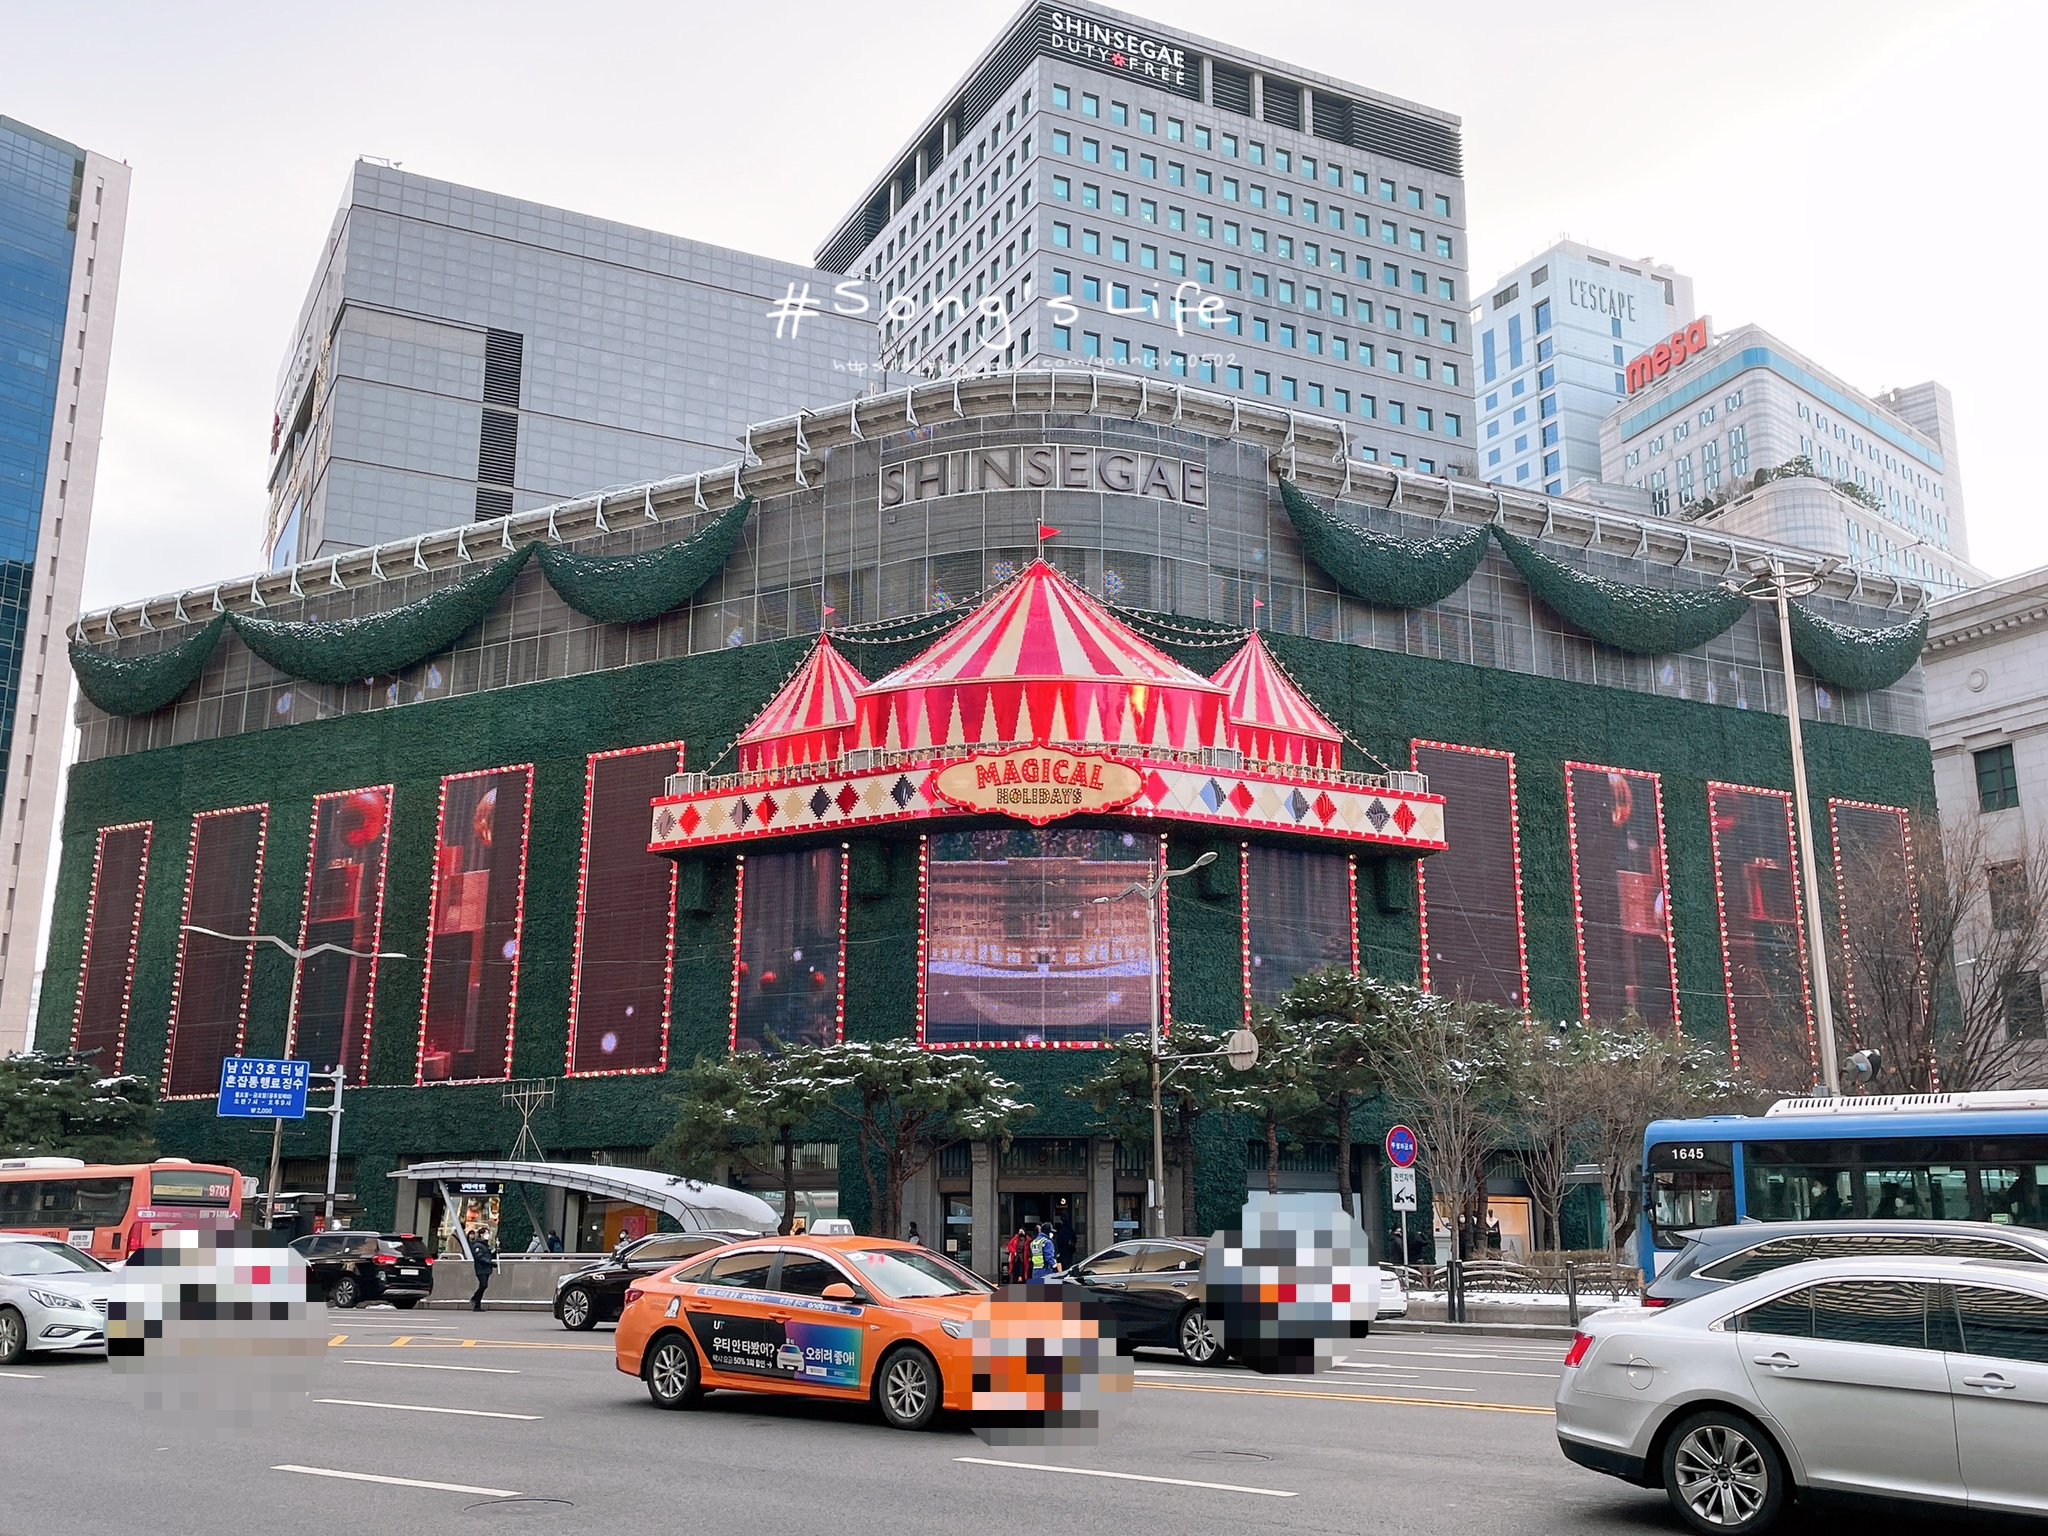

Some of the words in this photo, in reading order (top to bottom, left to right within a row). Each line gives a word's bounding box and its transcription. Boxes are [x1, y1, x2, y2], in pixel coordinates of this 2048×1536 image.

[1051, 12, 1185, 69] SHINSEGAE
[1051, 33, 1109, 62] DUTY
[1129, 56, 1185, 86] FREE
[1569, 277, 1636, 322] L'ESCAPE
[1626, 317, 1708, 394] mesa
[881, 448, 1206, 506] SHINSEGAE
[975, 758, 1104, 790] MAGICAL
[997, 788, 1083, 804] HOLIDAYS
[225, 1075, 304, 1091] 혼잡통행료징수
[1671, 1148, 1705, 1160] 1645
[209, 1185, 230, 1197] 9701
[733, 1356, 746, 1365] 50%
[805, 1347, 833, 1363] 오히려
